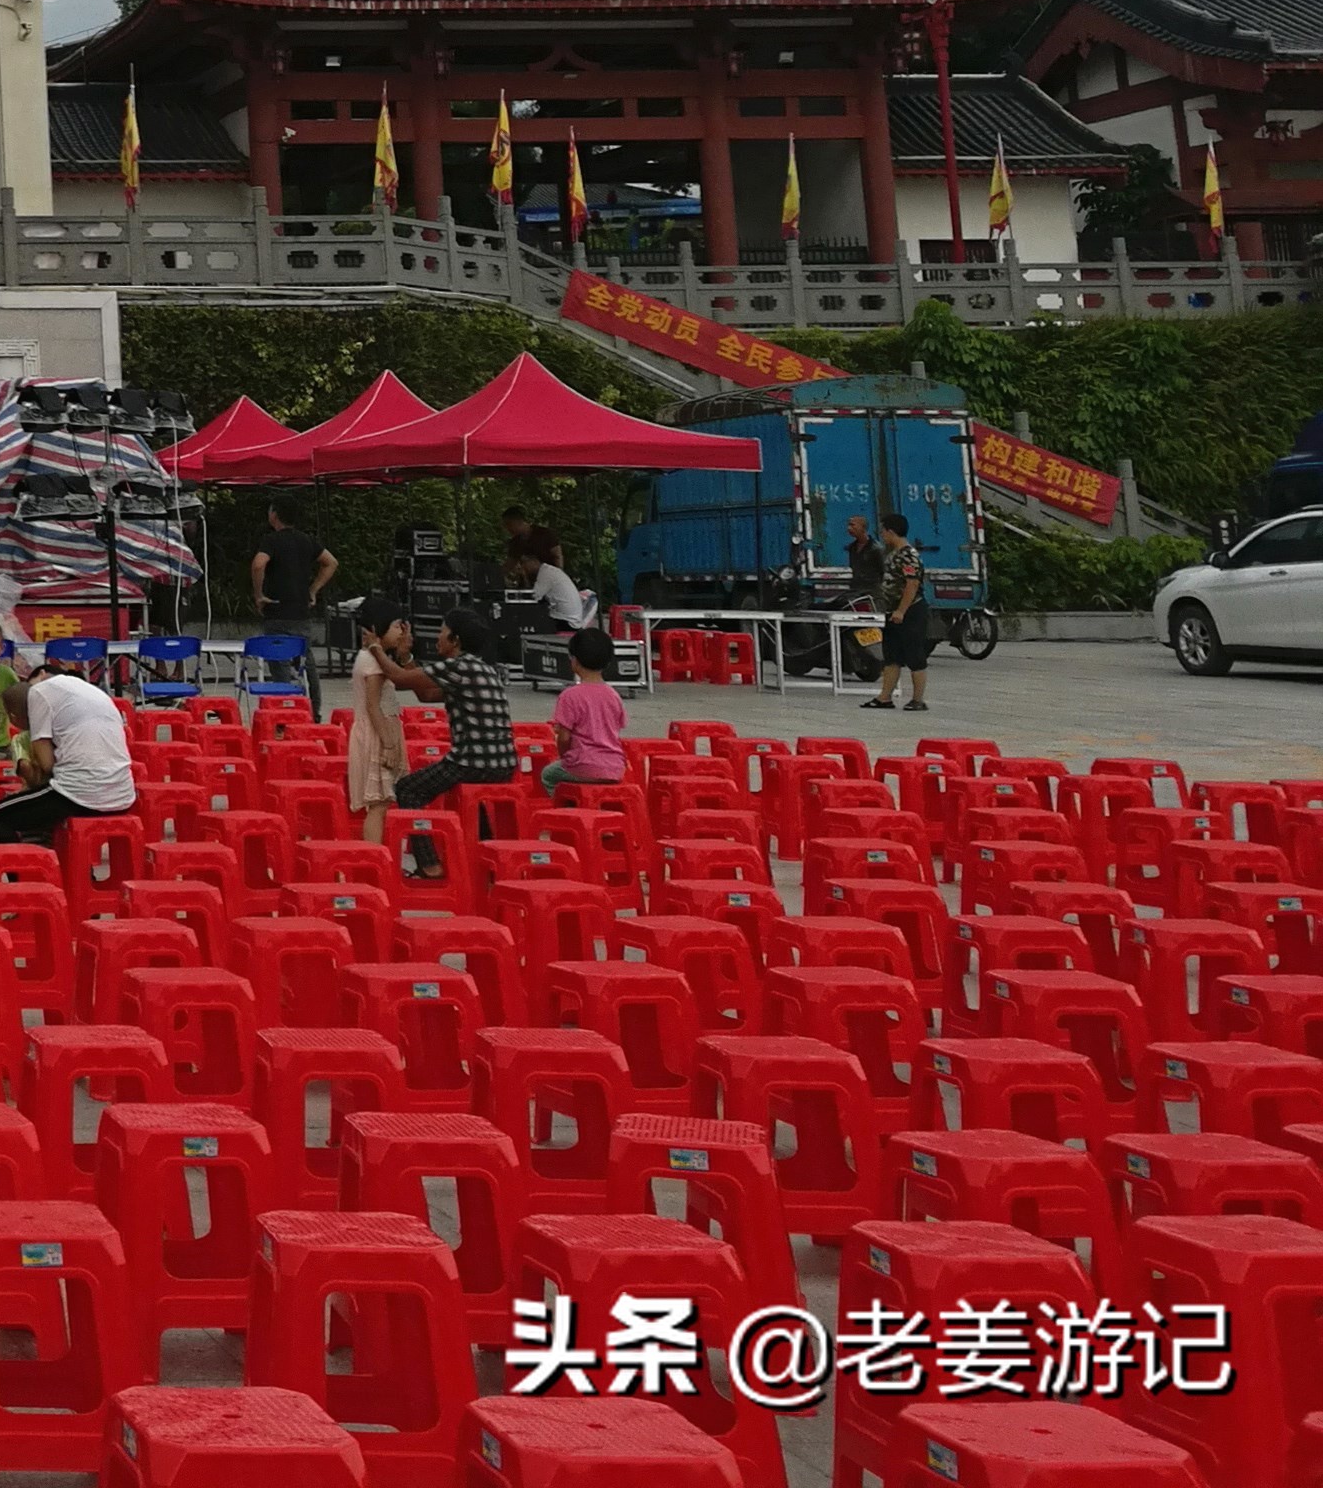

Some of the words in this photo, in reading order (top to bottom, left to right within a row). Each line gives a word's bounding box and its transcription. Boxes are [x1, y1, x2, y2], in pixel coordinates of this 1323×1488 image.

[584, 283, 702, 346] 全党动员
[981, 433, 1102, 500] 构建和谐
